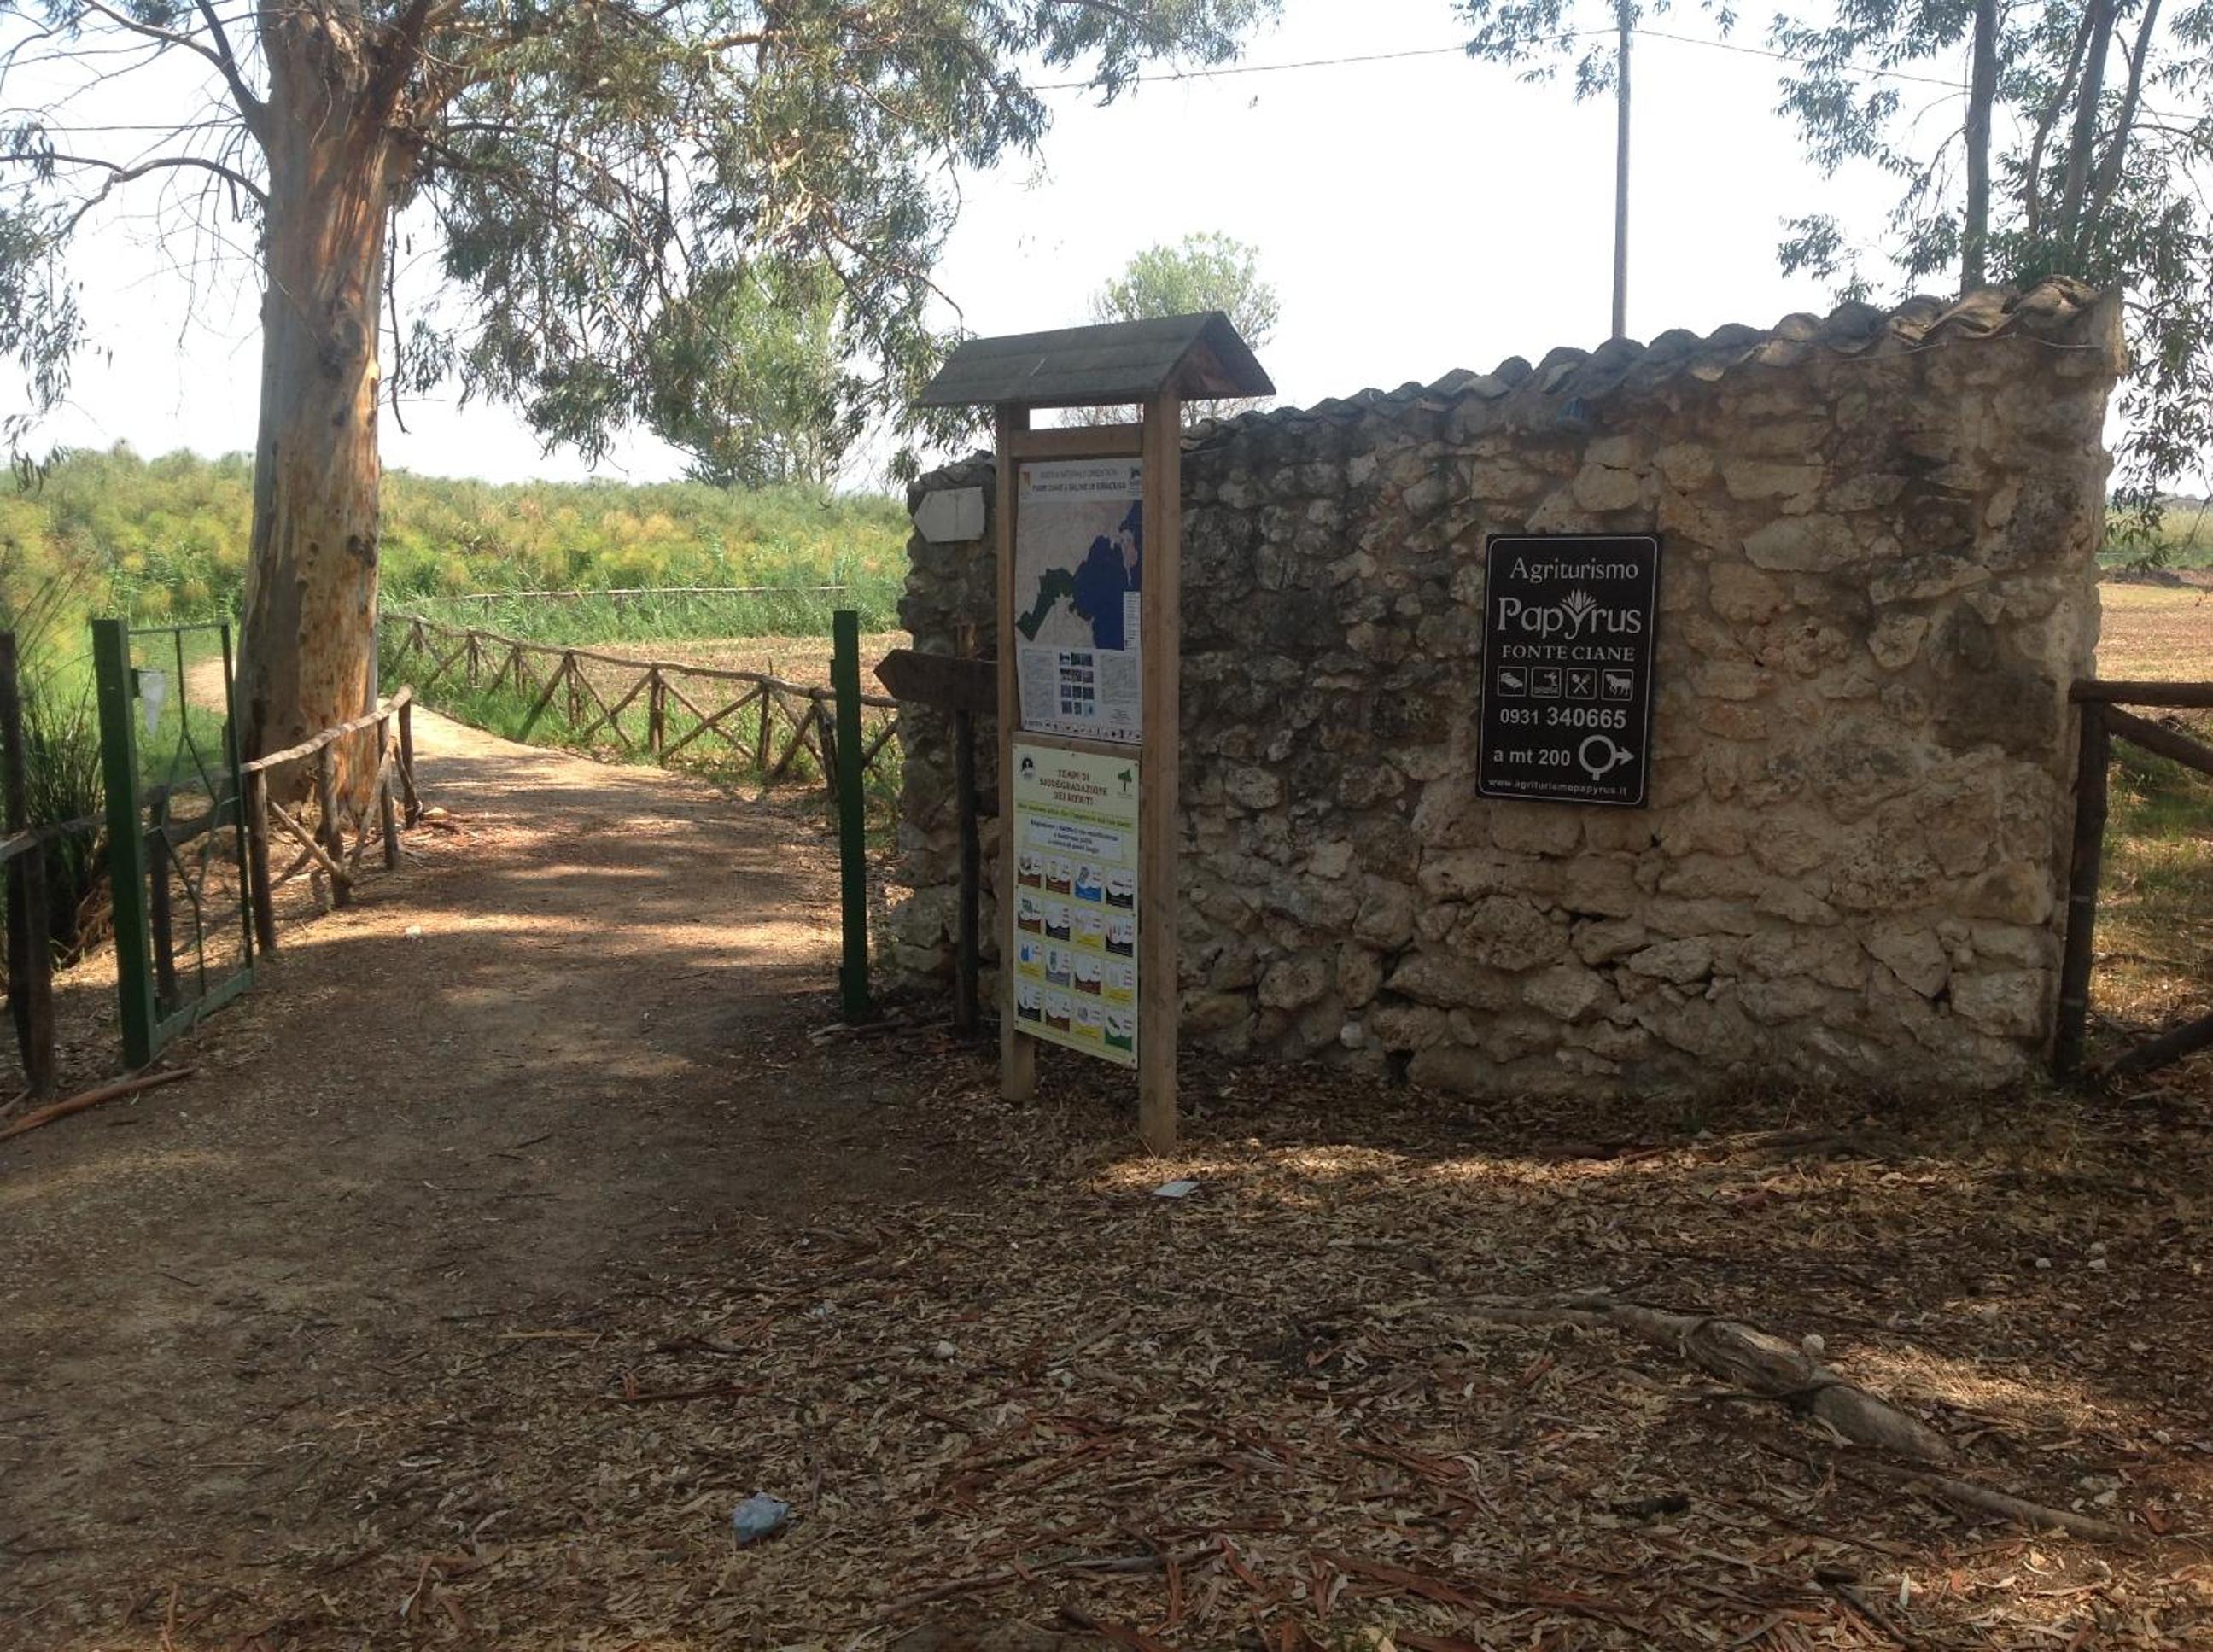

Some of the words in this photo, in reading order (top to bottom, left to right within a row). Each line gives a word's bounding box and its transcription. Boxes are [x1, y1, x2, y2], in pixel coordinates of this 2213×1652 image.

[1509, 557, 1639, 585] Agriturismo
[1497, 588, 1642, 639] Papyrus
[1502, 645, 1568, 659] FONTE
[1572, 645, 1636, 662] CIANE
[1499, 708, 1539, 725] 0931
[1546, 707, 1627, 729] 340665
[1493, 750, 1504, 762] a
[1509, 748, 1533, 764] mt
[1539, 749, 1571, 767] 200
[1488, 778, 1627, 796] www.agriturismopapyrus.it
